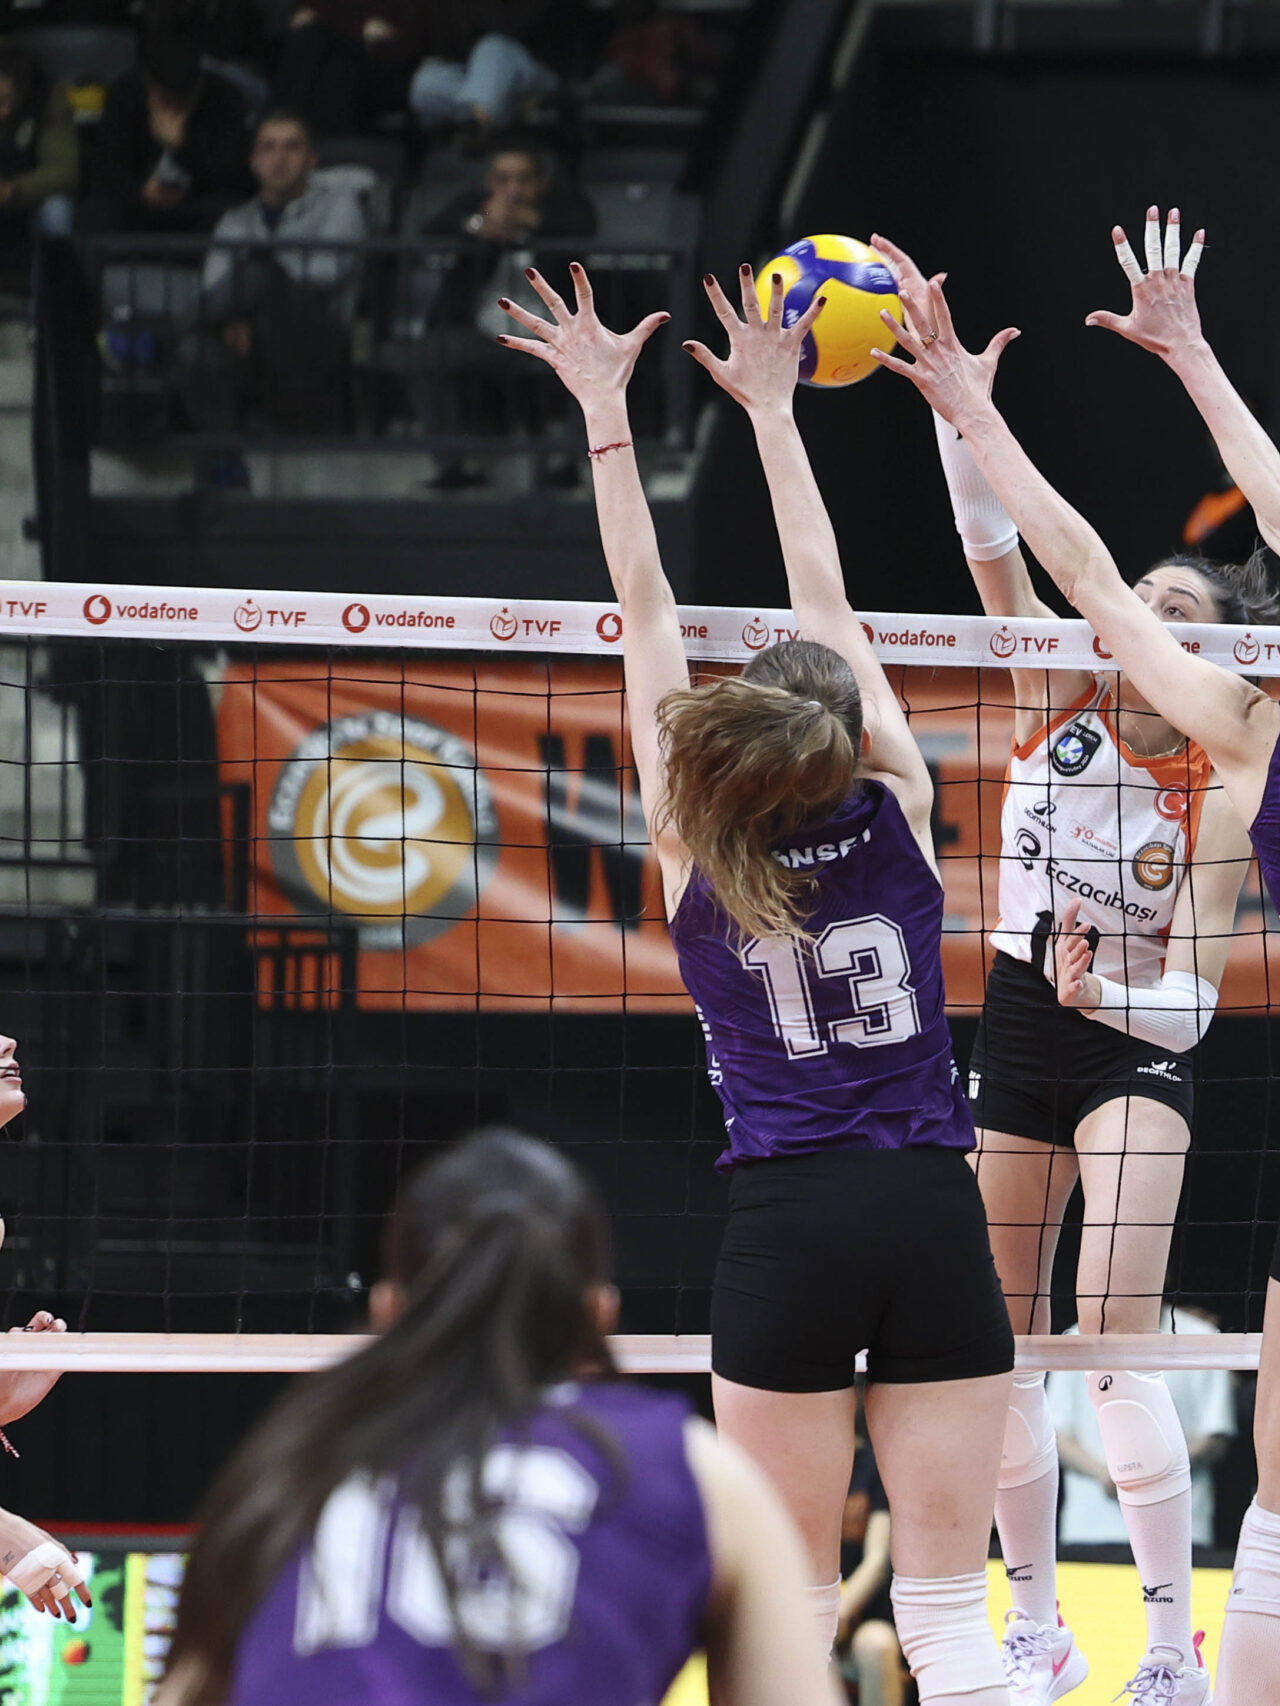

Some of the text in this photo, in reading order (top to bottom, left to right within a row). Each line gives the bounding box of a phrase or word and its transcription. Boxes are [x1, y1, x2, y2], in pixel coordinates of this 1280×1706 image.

[6, 601, 47, 618] TVF
[117, 603, 199, 620] vodafone
[267, 610, 307, 627] TVF
[375, 611, 455, 628] vodafone
[522, 619, 561, 637] TVF
[774, 629, 800, 643] TV
[879, 630, 956, 647] vodafone
[1021, 637, 1059, 653] TVF
[740, 913, 922, 1061] 13
